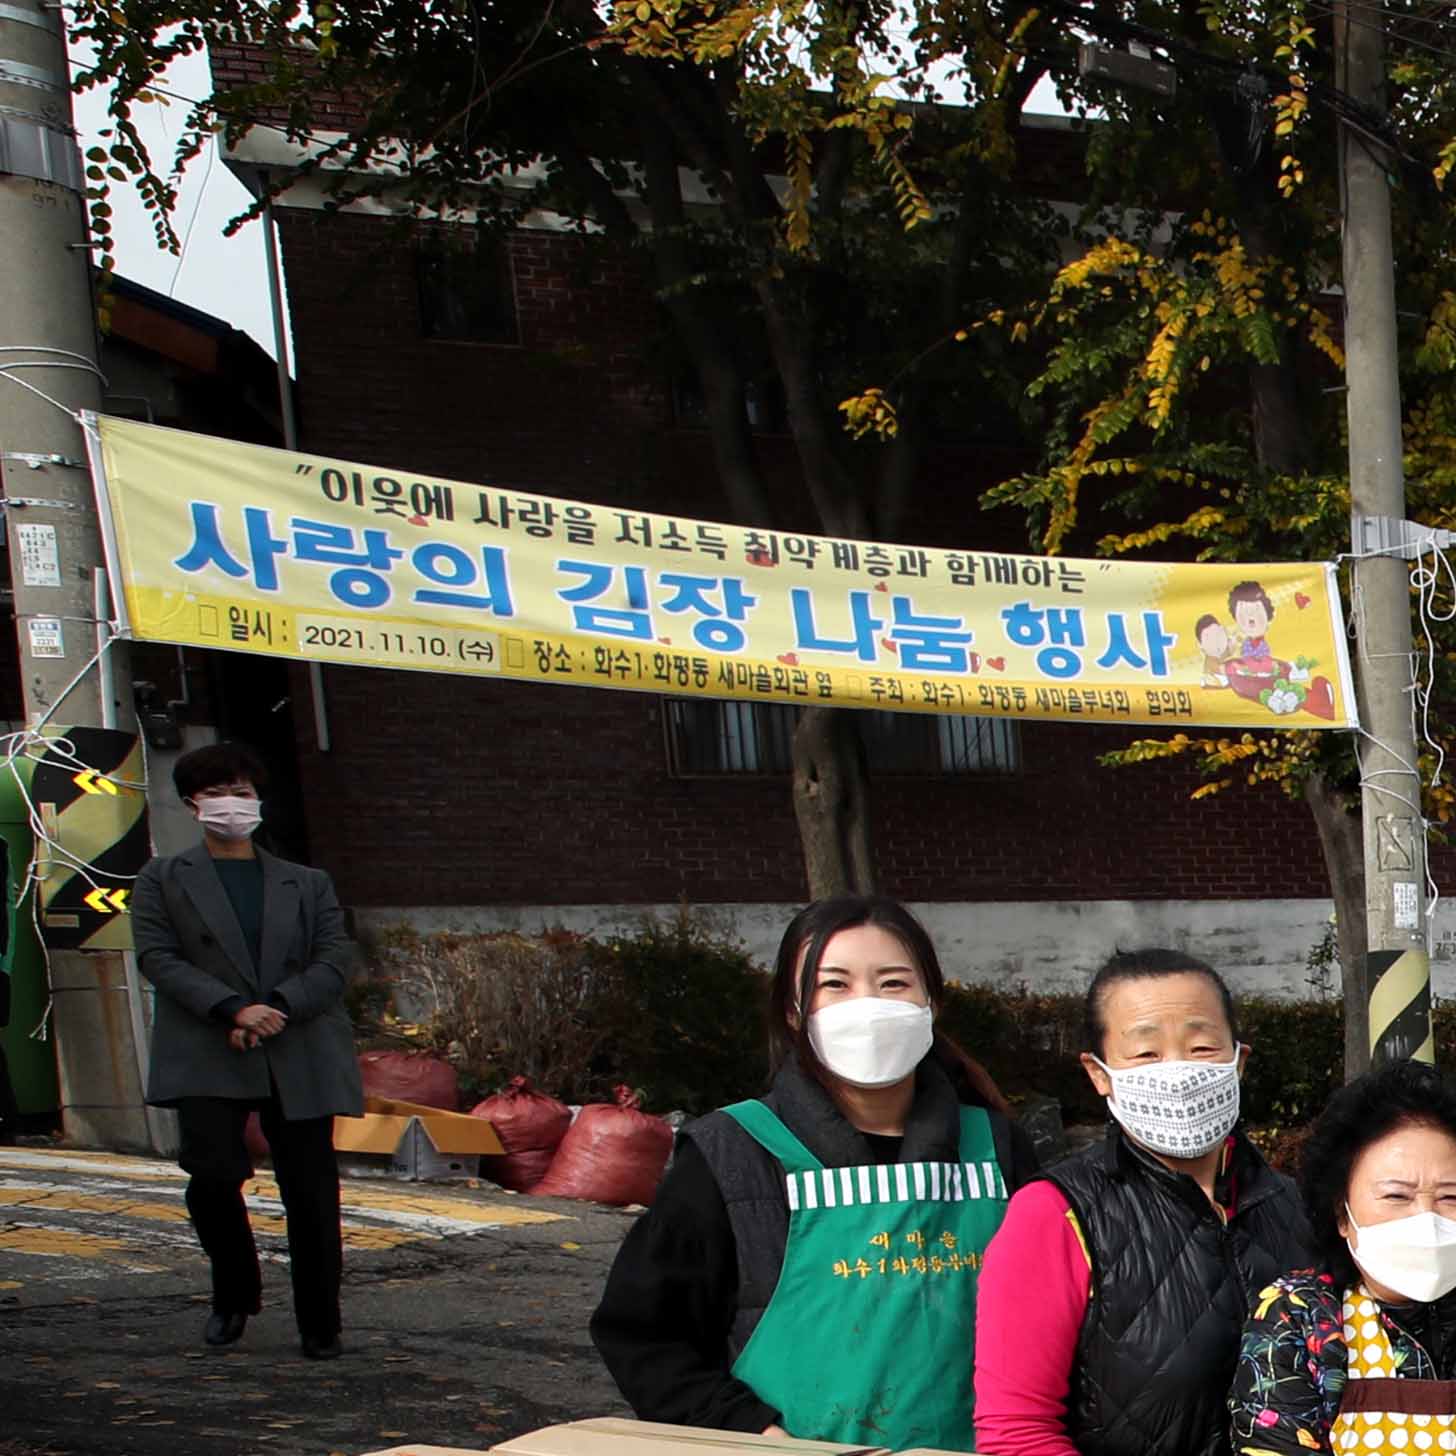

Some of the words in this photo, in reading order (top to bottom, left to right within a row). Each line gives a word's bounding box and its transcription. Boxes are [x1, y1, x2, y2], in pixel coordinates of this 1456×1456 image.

[473, 491, 598, 547] 사랑을
[613, 512, 728, 561] 저소득
[175, 500, 516, 618] 사랑의
[556, 558, 758, 653] 김장
[789, 587, 976, 675] 나눔
[1001, 602, 1177, 680] 행사
[228, 605, 274, 646] 일시
[533, 639, 572, 673] 장소
[717, 660, 810, 697] 새마을회관
[869, 675, 904, 705] 주최
